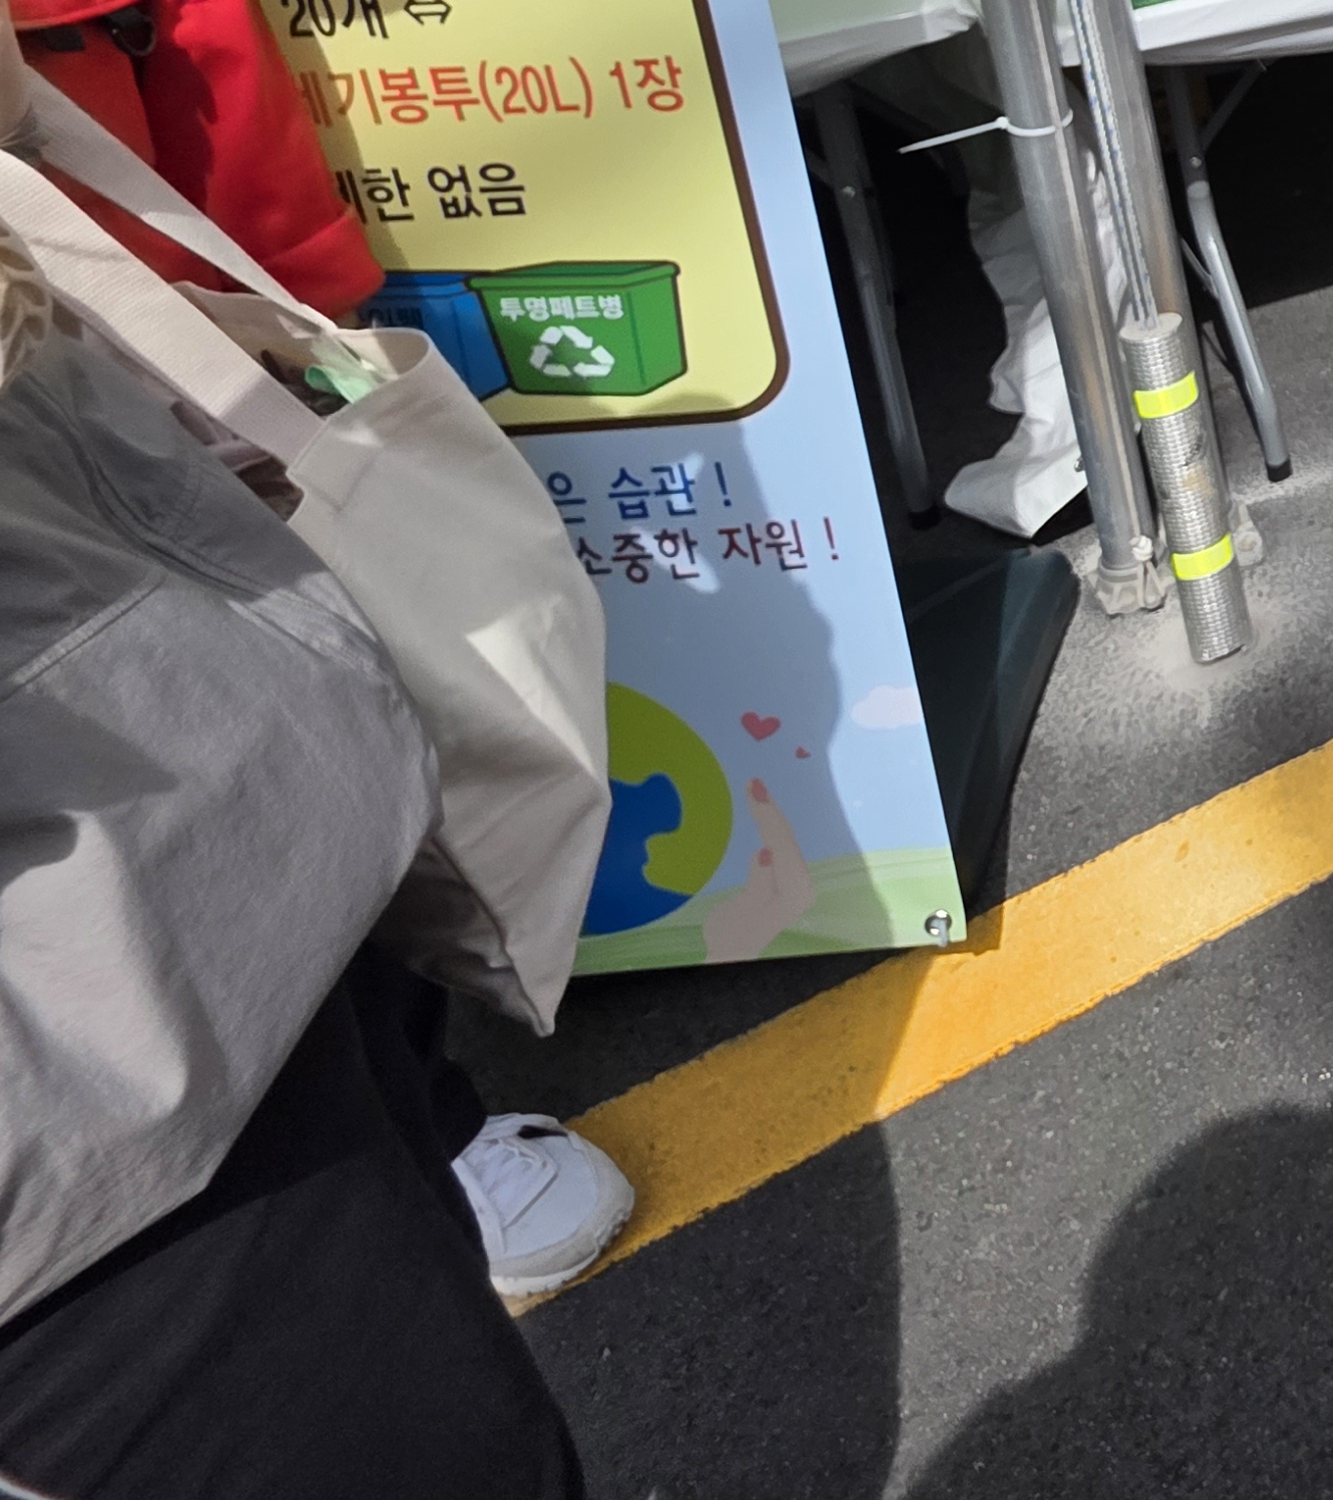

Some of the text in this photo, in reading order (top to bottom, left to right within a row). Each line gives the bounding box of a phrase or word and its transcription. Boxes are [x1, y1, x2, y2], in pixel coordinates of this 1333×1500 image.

[610, 55, 685, 112] 1장
[427, 162, 527, 220] 없음
[499, 294, 625, 322] 투명페트병
[608, 462, 698, 521] 습관
[576, 527, 702, 585] 소중한
[717, 516, 809, 572] 자원
